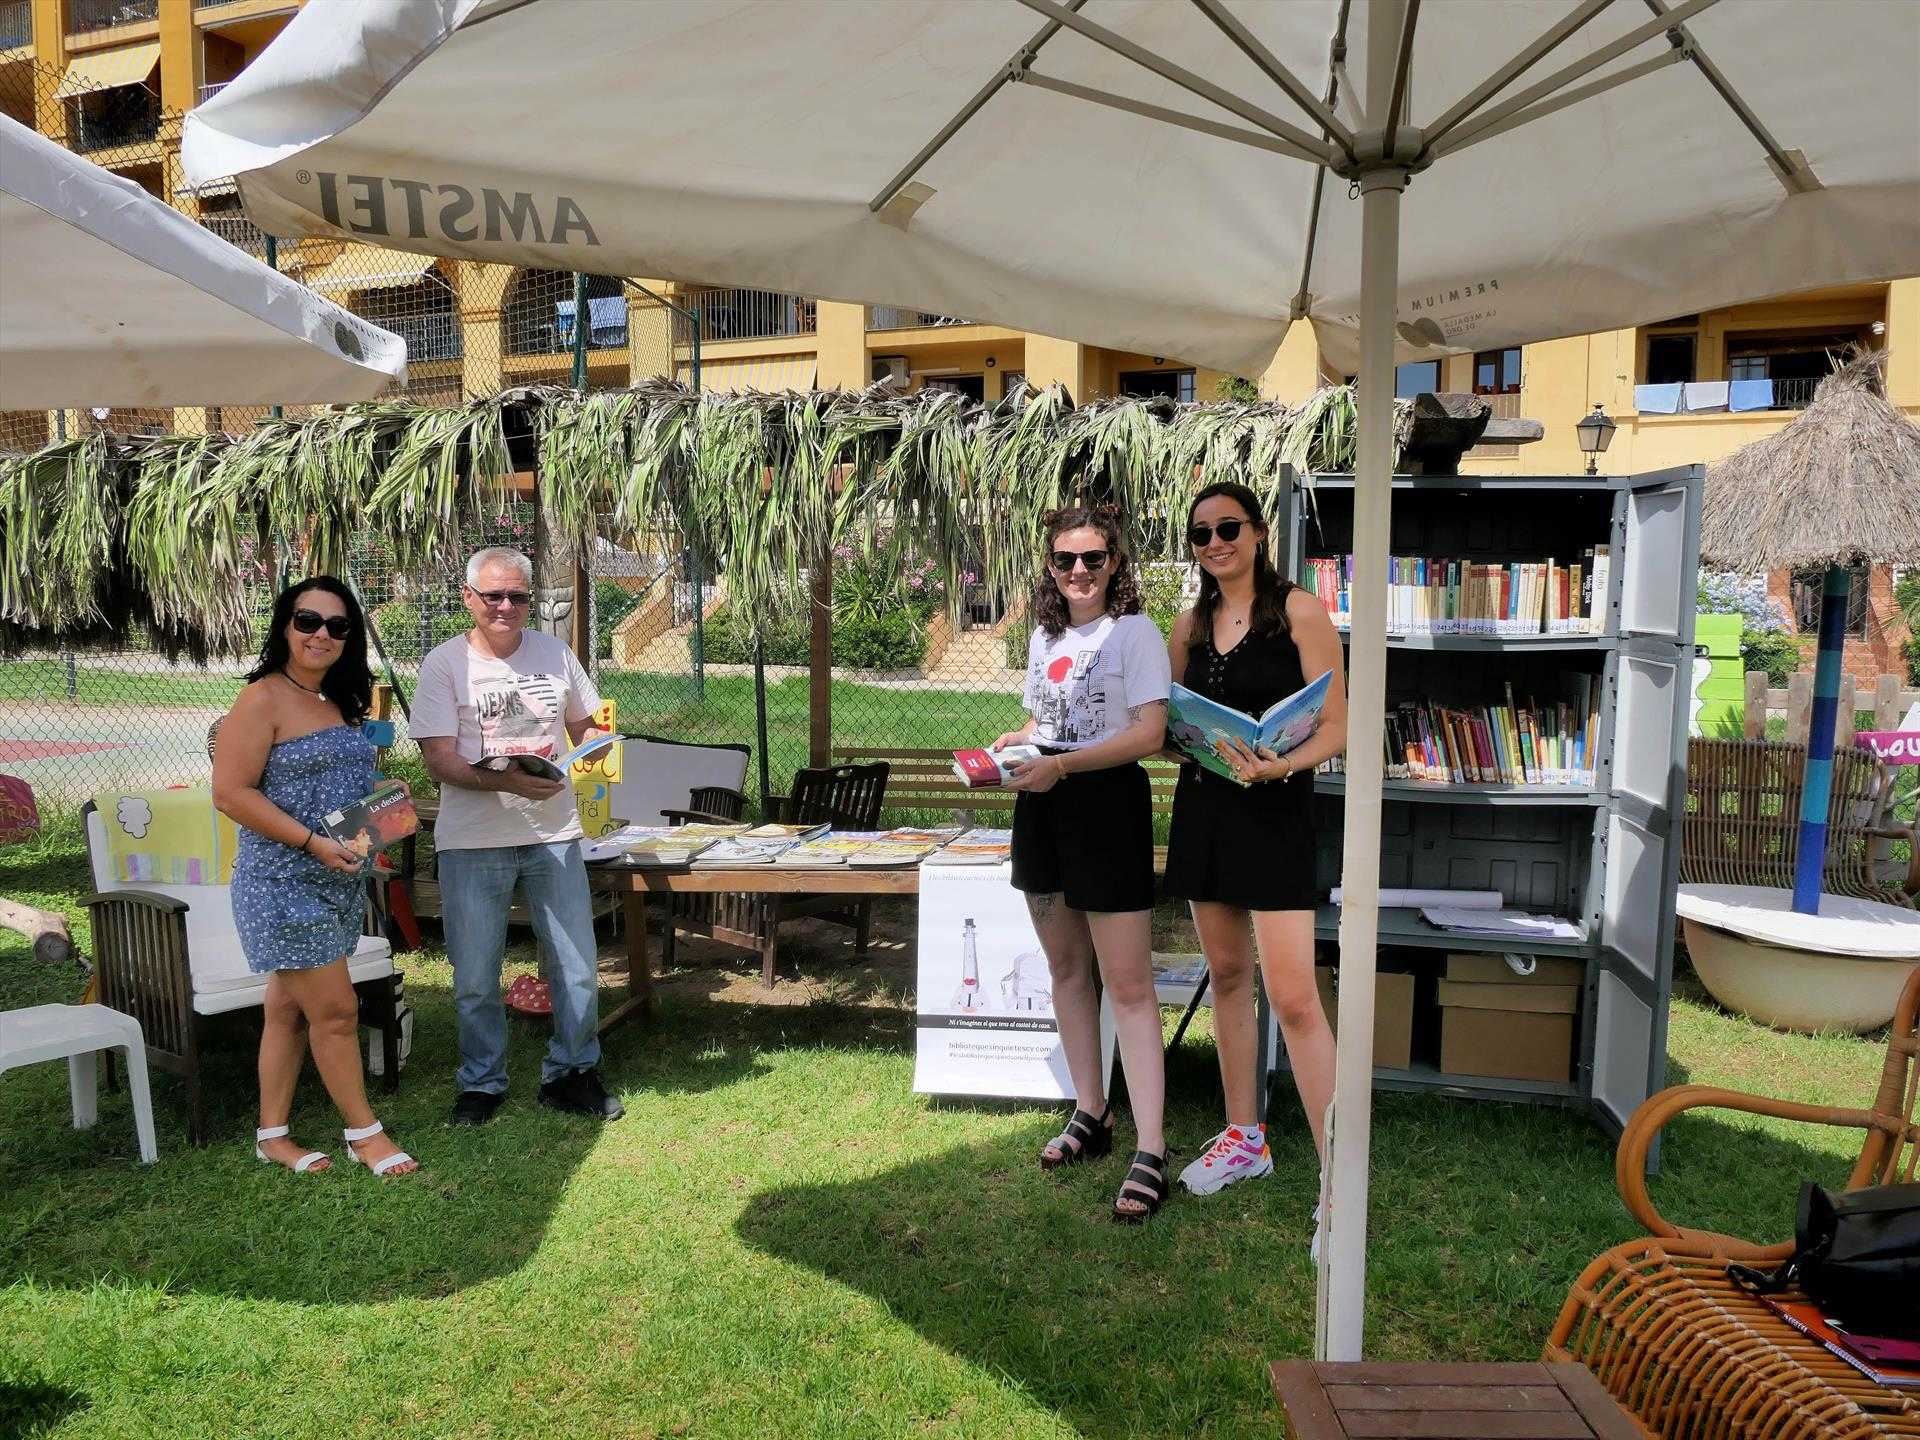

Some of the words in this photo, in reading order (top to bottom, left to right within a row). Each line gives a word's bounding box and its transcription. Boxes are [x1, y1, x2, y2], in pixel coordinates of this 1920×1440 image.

[1584, 592, 1592, 604] Dick
[481, 689, 524, 719] JEANS
[369, 802, 380, 814] La
[381, 791, 405, 808] decisió
